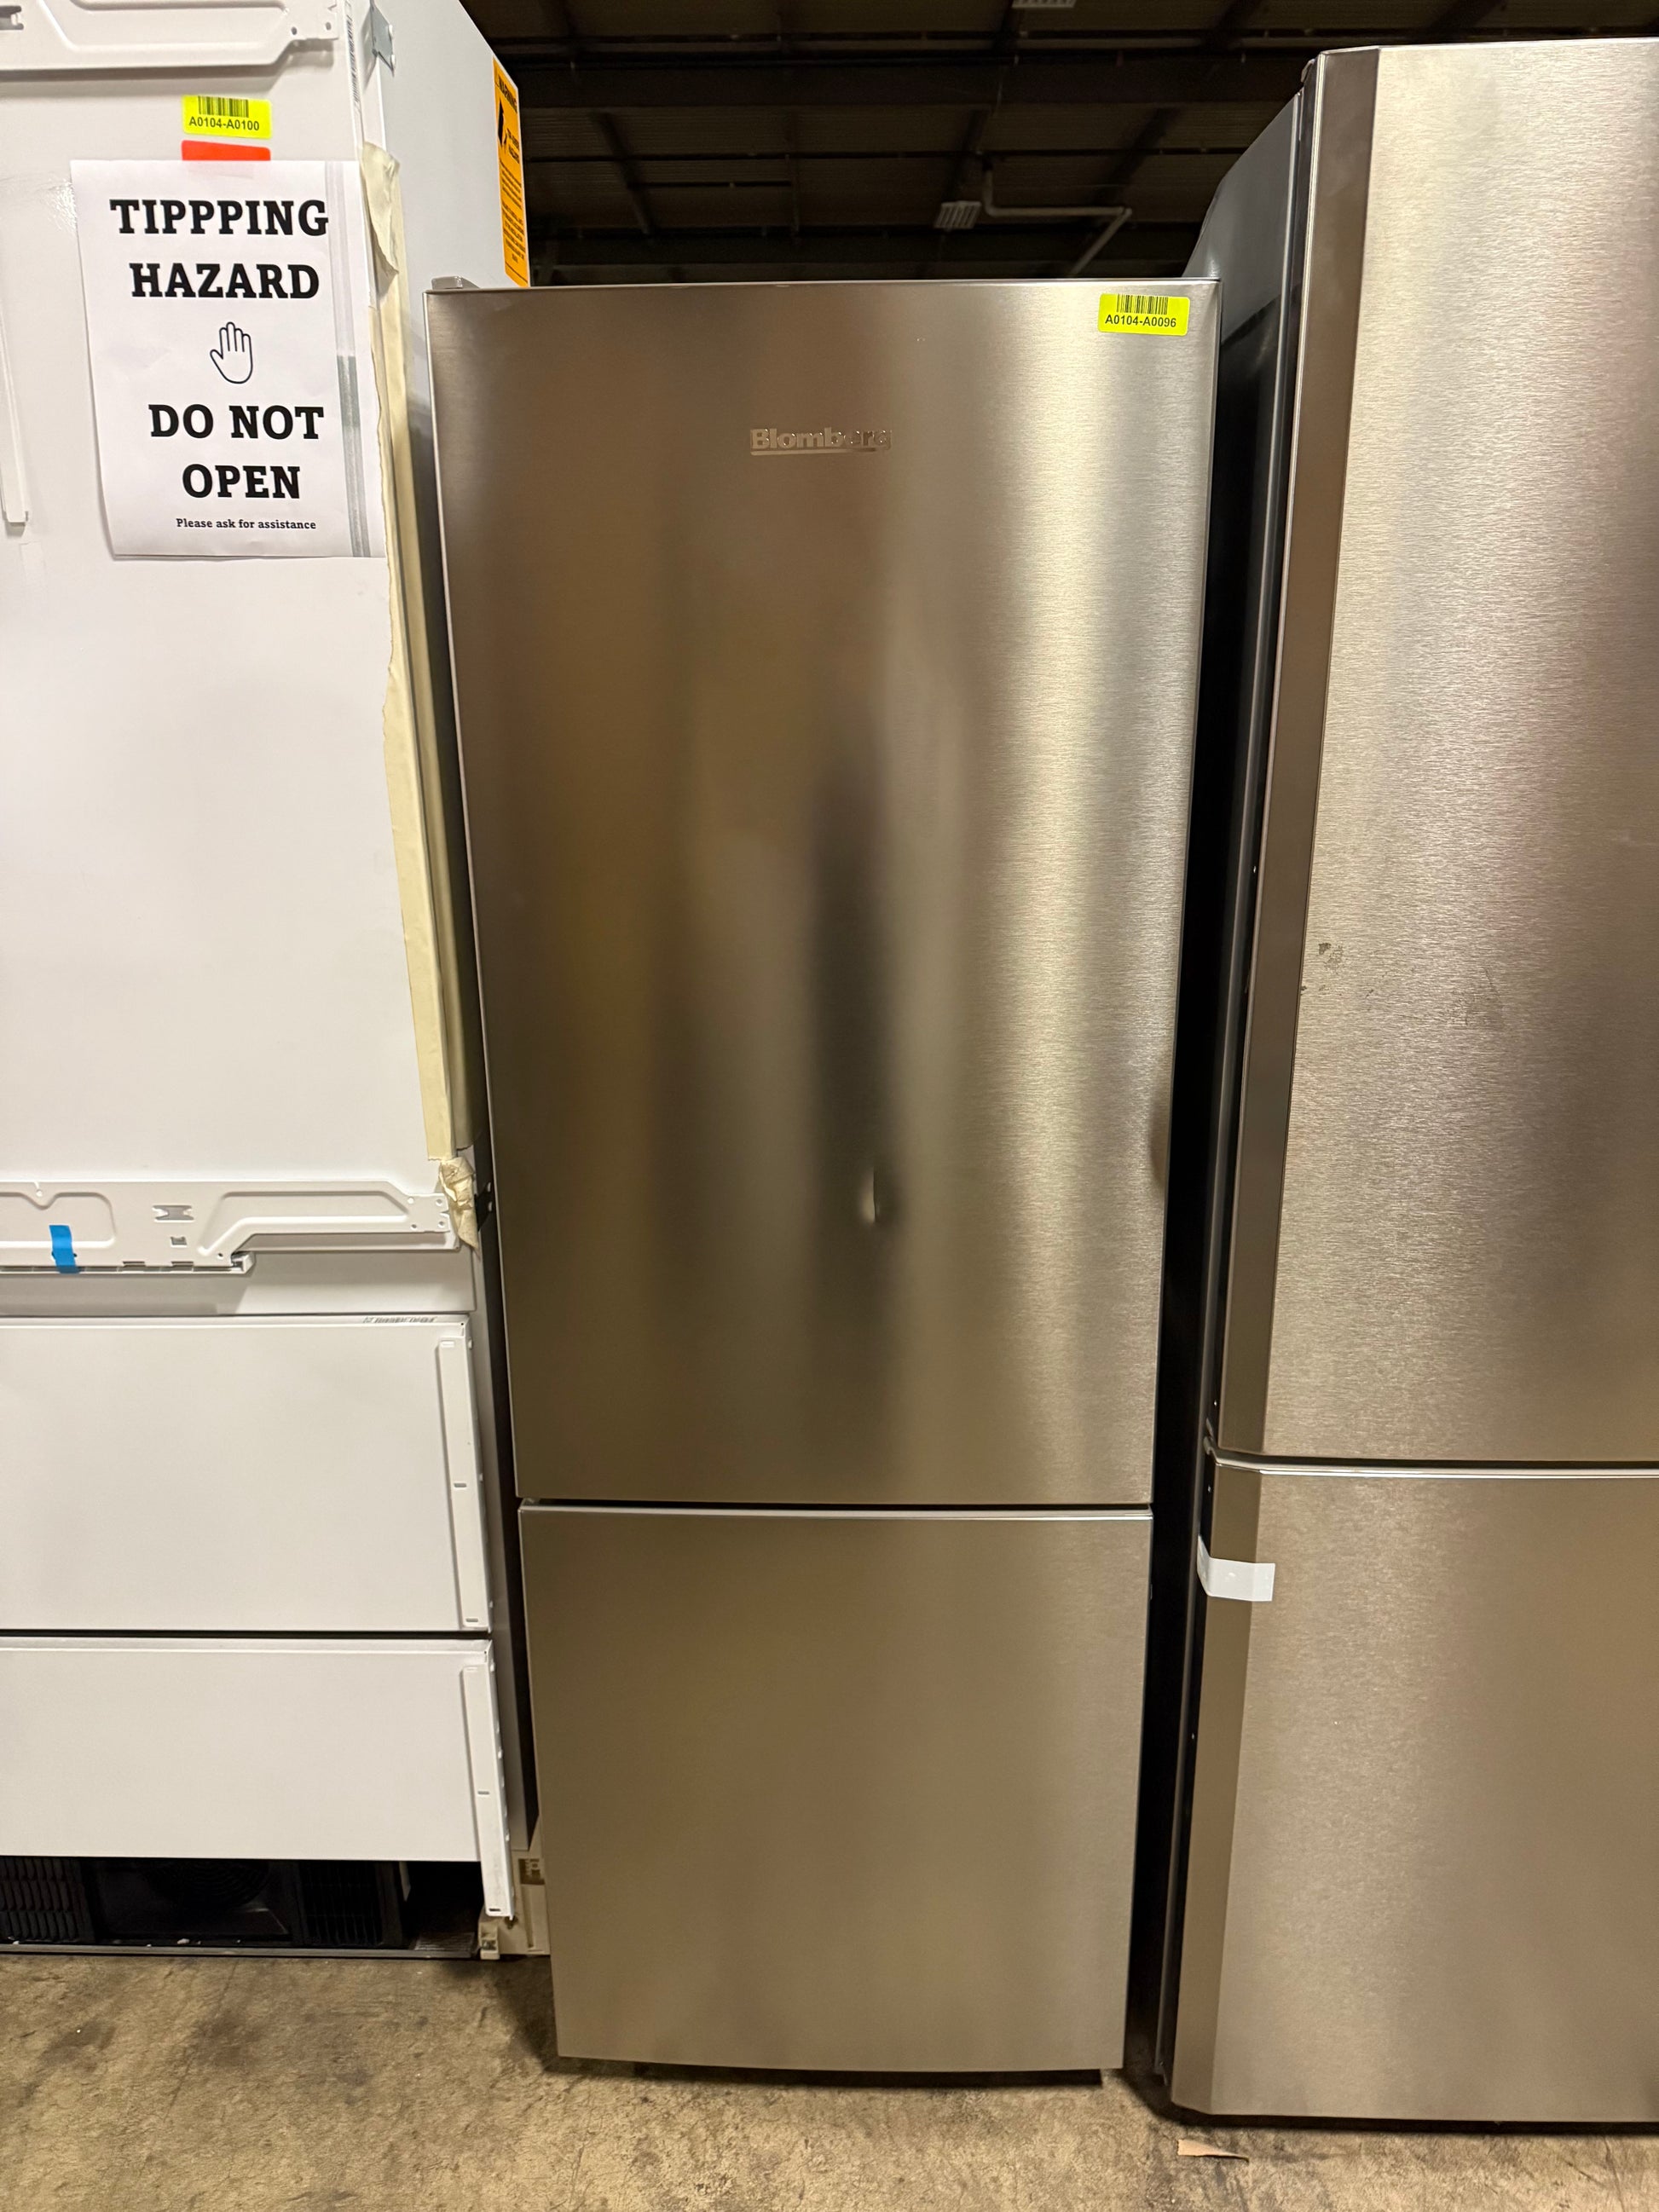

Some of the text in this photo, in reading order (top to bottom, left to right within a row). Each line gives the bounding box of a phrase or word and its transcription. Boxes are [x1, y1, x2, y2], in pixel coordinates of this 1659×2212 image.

[188, 116, 260, 131] A0104-A0100
[109, 199, 329, 237] TIPPPING
[129, 263, 320, 299] HAZARD
[1104, 314, 1177, 328] A0104-A0096
[148, 403, 325, 440] DO NOT
[750, 427, 893, 452] Blomberg
[182, 464, 301, 499] OPEN
[176, 518, 316, 529] Please ask for assistance
